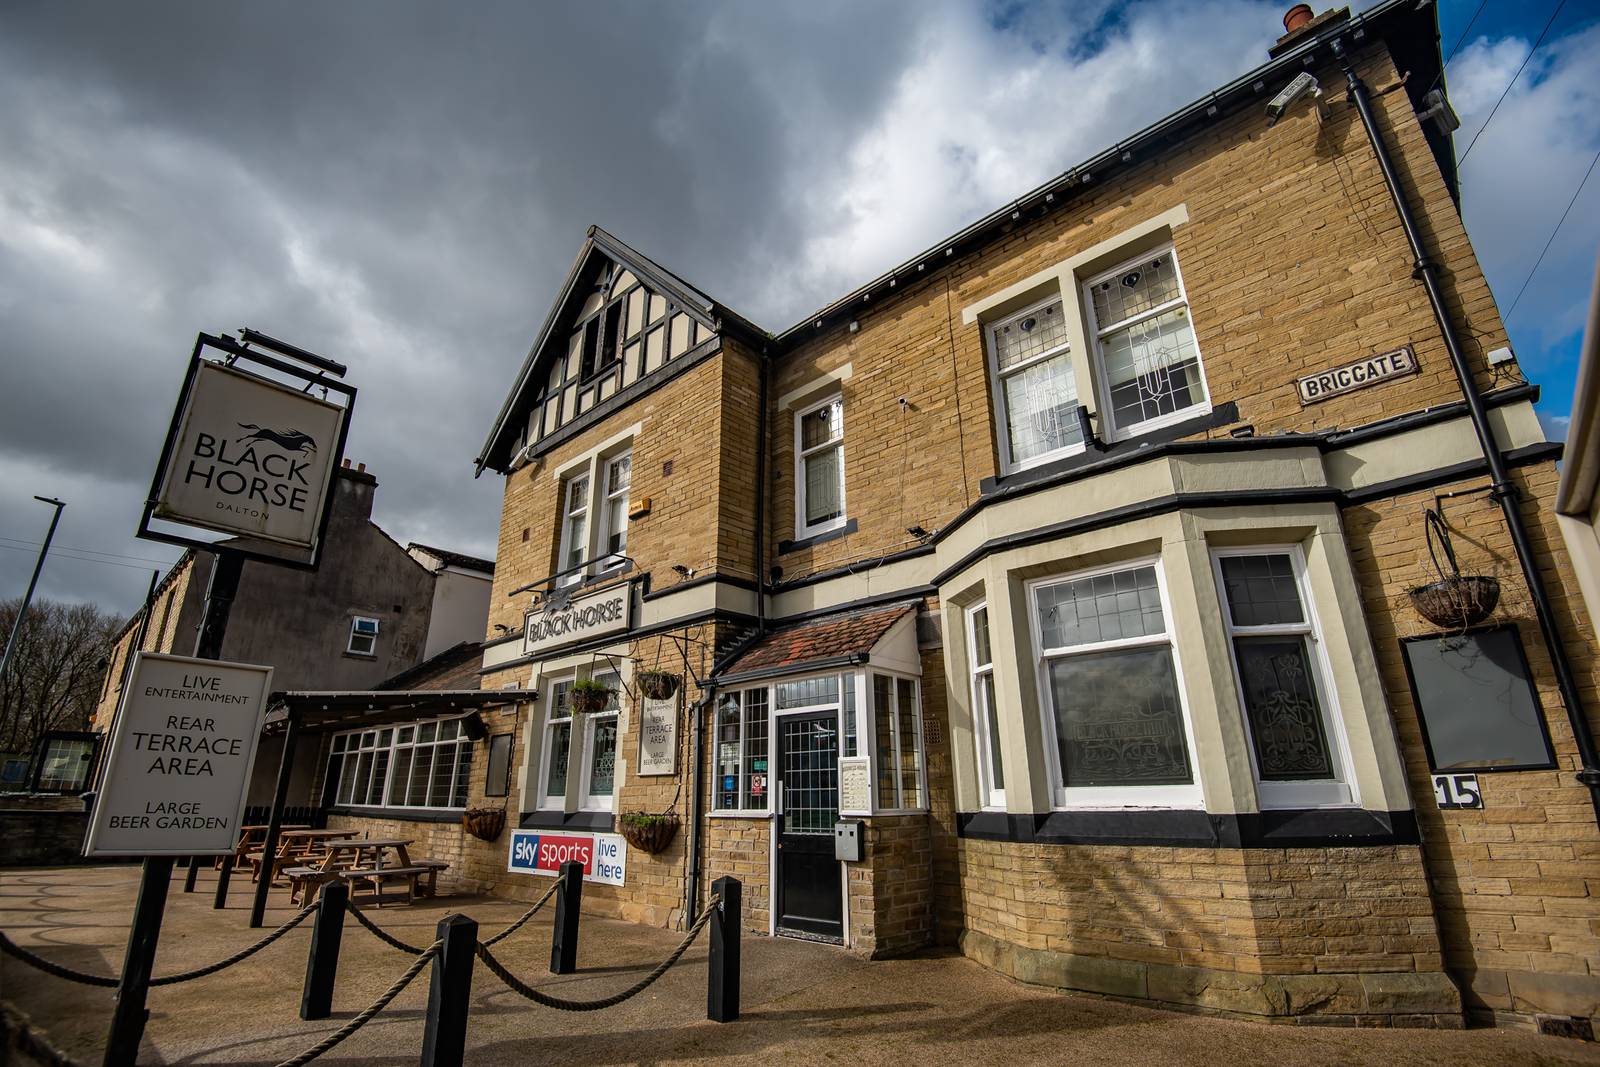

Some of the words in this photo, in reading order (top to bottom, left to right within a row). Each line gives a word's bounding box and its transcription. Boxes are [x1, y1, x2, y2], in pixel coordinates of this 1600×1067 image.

[1305, 352, 1406, 397] BRIGGATE
[194, 432, 310, 486] BLACK
[184, 460, 308, 513] HORSE
[215, 501, 270, 520] DALTON
[529, 612, 572, 643] BLACK
[573, 597, 624, 632] HORSE
[182, 674, 221, 691] LIVE
[145, 686, 249, 705] ENTERTAINMENT
[166, 715, 216, 732] REAR
[645, 724, 673, 735] TERRACE
[132, 732, 243, 756] TERRACE
[650, 735, 666, 744] AREA
[650, 751, 665, 759] LARGE
[147, 756, 214, 777] AREA
[1435, 775, 1480, 808] 15
[145, 802, 201, 815] LARGE
[109, 815, 150, 829] BEER
[156, 816, 228, 830] GARDEN
[515, 837, 538, 866] sky
[541, 841, 589, 867] sports
[598, 838, 617, 857] live
[597, 859, 622, 879] here
